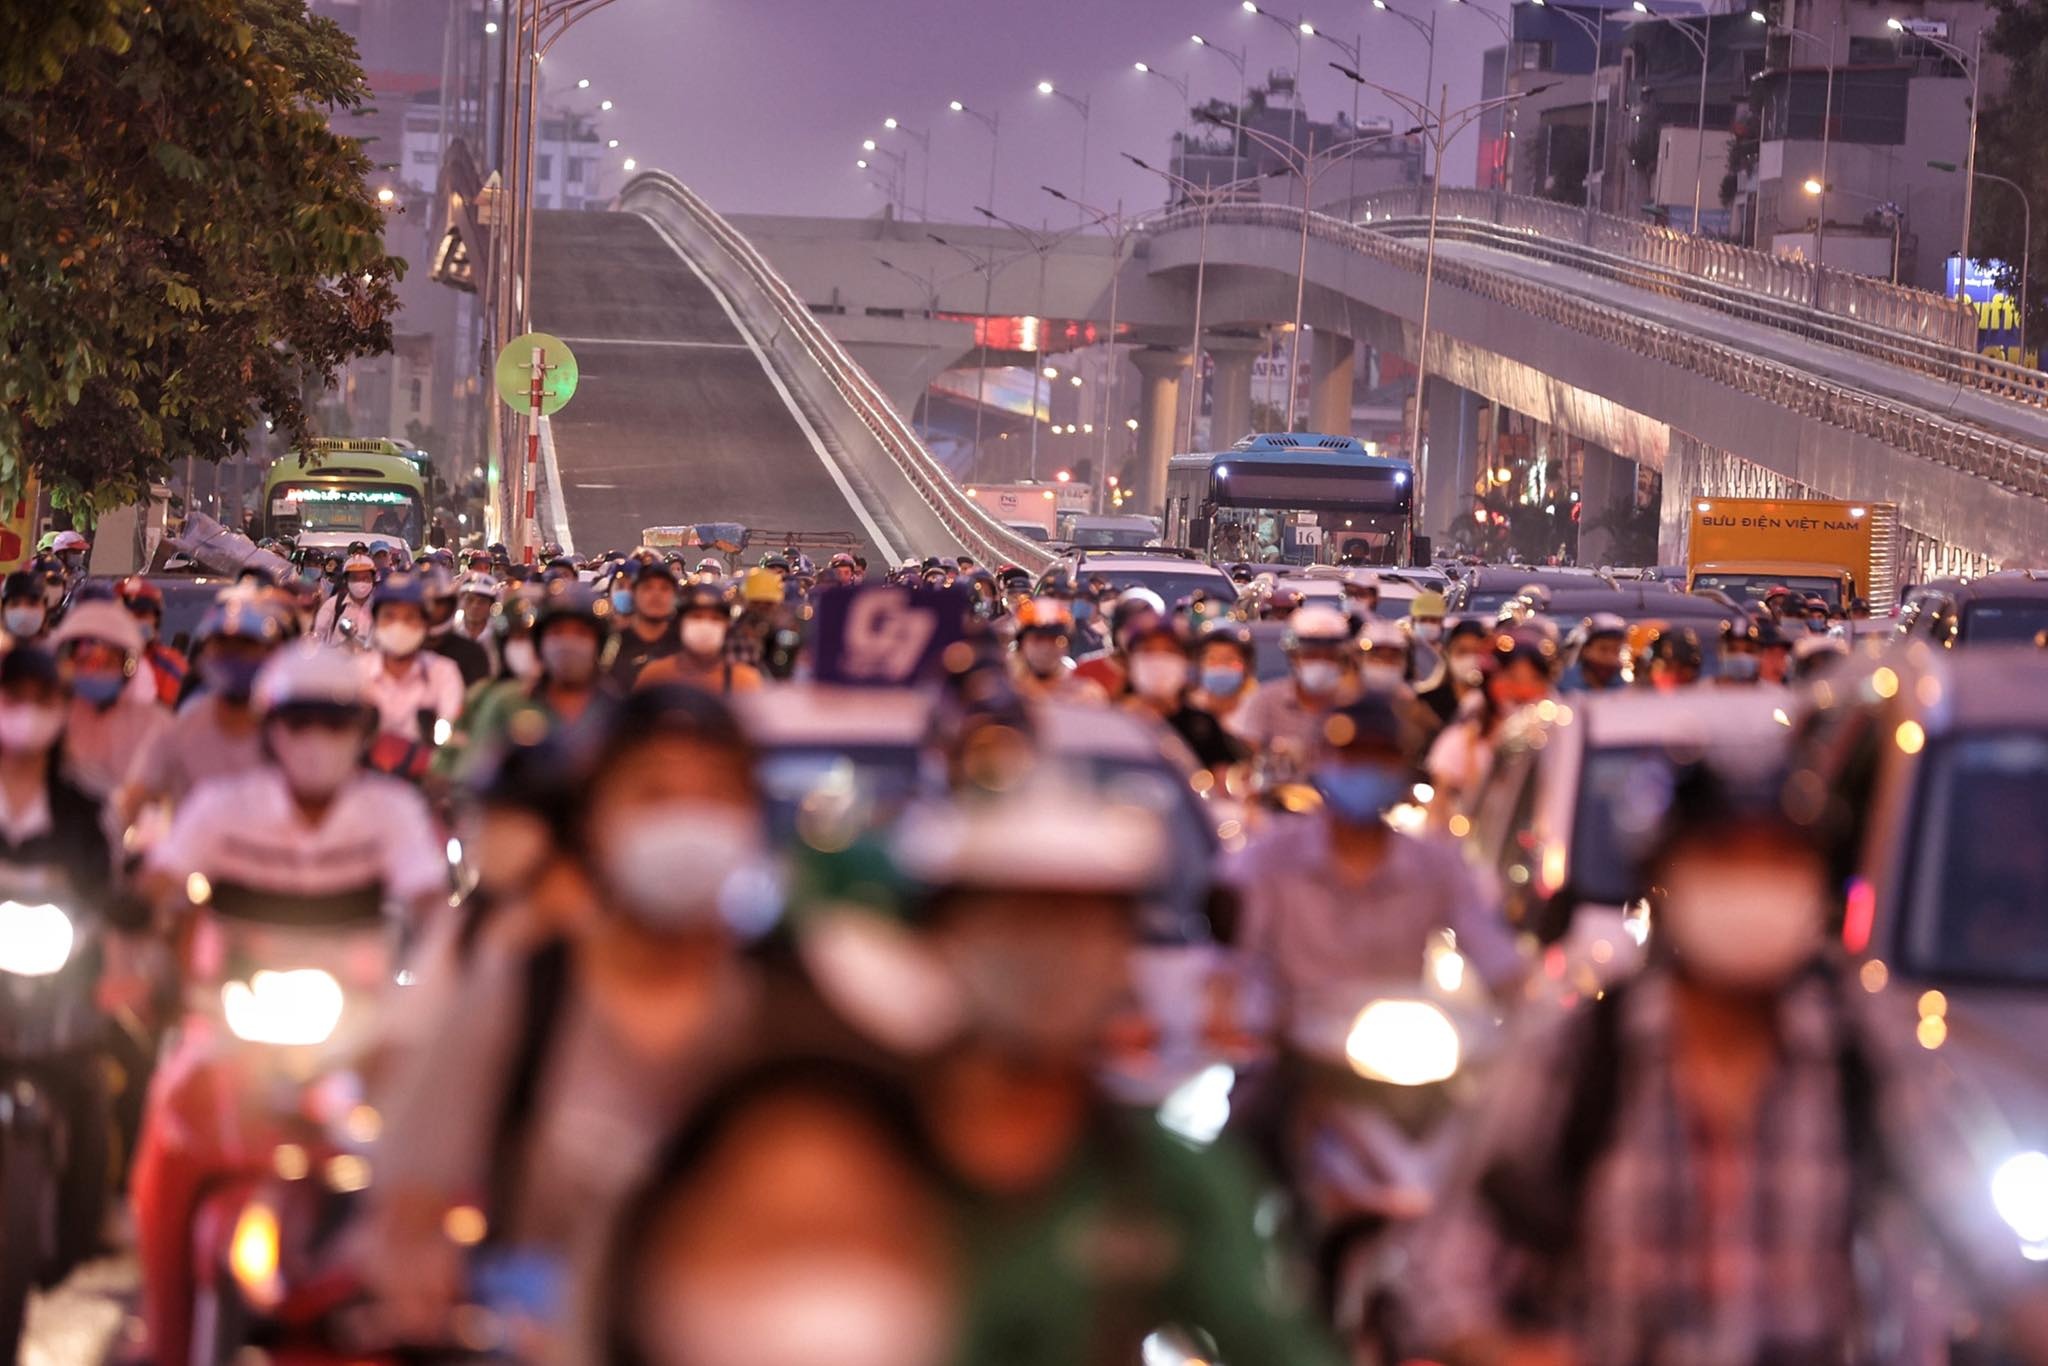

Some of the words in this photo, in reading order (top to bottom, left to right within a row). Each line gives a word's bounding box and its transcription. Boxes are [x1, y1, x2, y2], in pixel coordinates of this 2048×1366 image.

[1703, 515, 1736, 526] BƯU
[1742, 515, 1780, 531] ĐIỆN
[1785, 516, 1820, 531] VIỆT
[1824, 521, 1859, 531] NAM
[1299, 531, 1314, 544] 16
